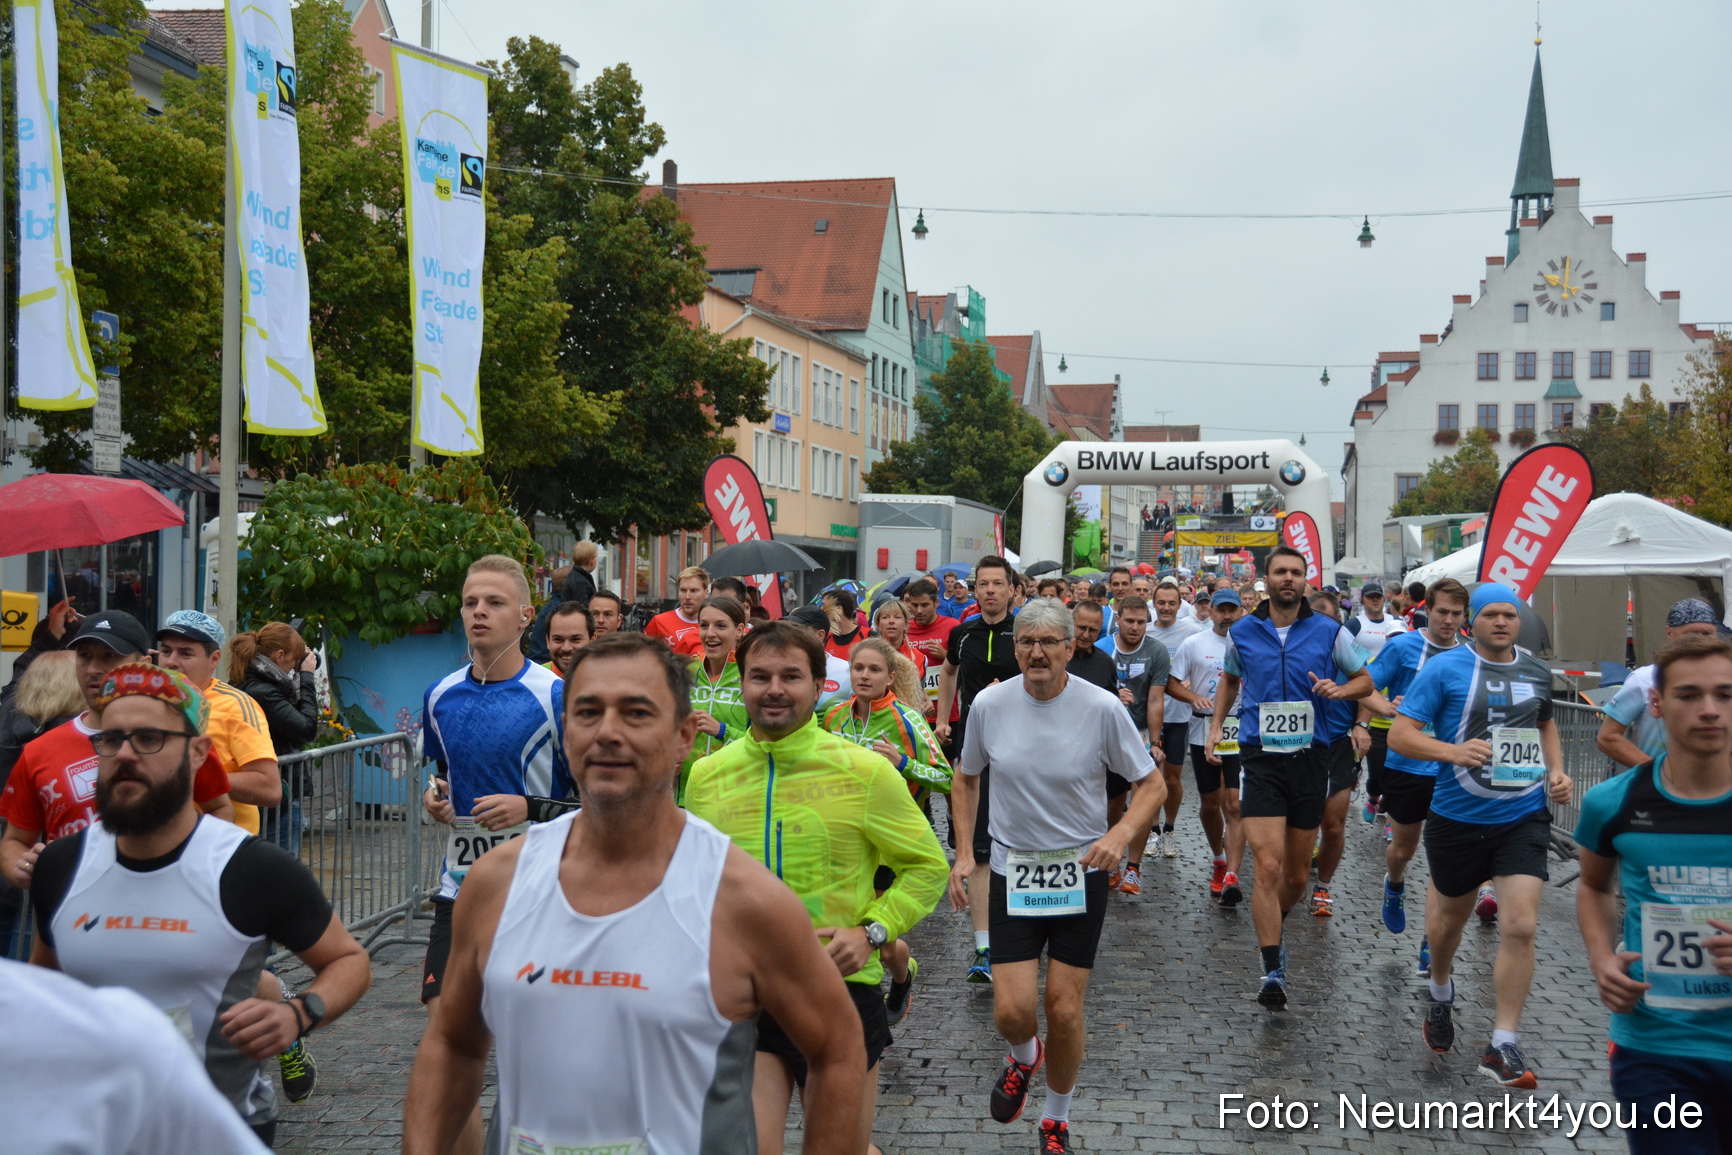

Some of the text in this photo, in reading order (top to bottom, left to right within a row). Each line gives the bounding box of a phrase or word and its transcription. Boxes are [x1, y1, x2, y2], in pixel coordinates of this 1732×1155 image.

[1077, 450, 1270, 474] BMW Laufsport
[1215, 534, 1239, 544] ZIEL
[1488, 464, 1578, 595] REWE
[1265, 713, 1308, 733] 2281
[1222, 726, 1239, 740] 52
[1271, 737, 1303, 746] Bernhard
[1500, 742, 1541, 764] 2042
[70, 759, 99, 775] raumb
[1512, 769, 1533, 779] Georg
[1015, 861, 1078, 889] 2423
[1647, 866, 1732, 886] HUBE
[1024, 894, 1069, 906] Bernhard
[105, 915, 197, 934] KLEBL
[1653, 929, 1722, 969] 25
[551, 968, 649, 990] KLEBL
[1683, 978, 1731, 995] Lukas
